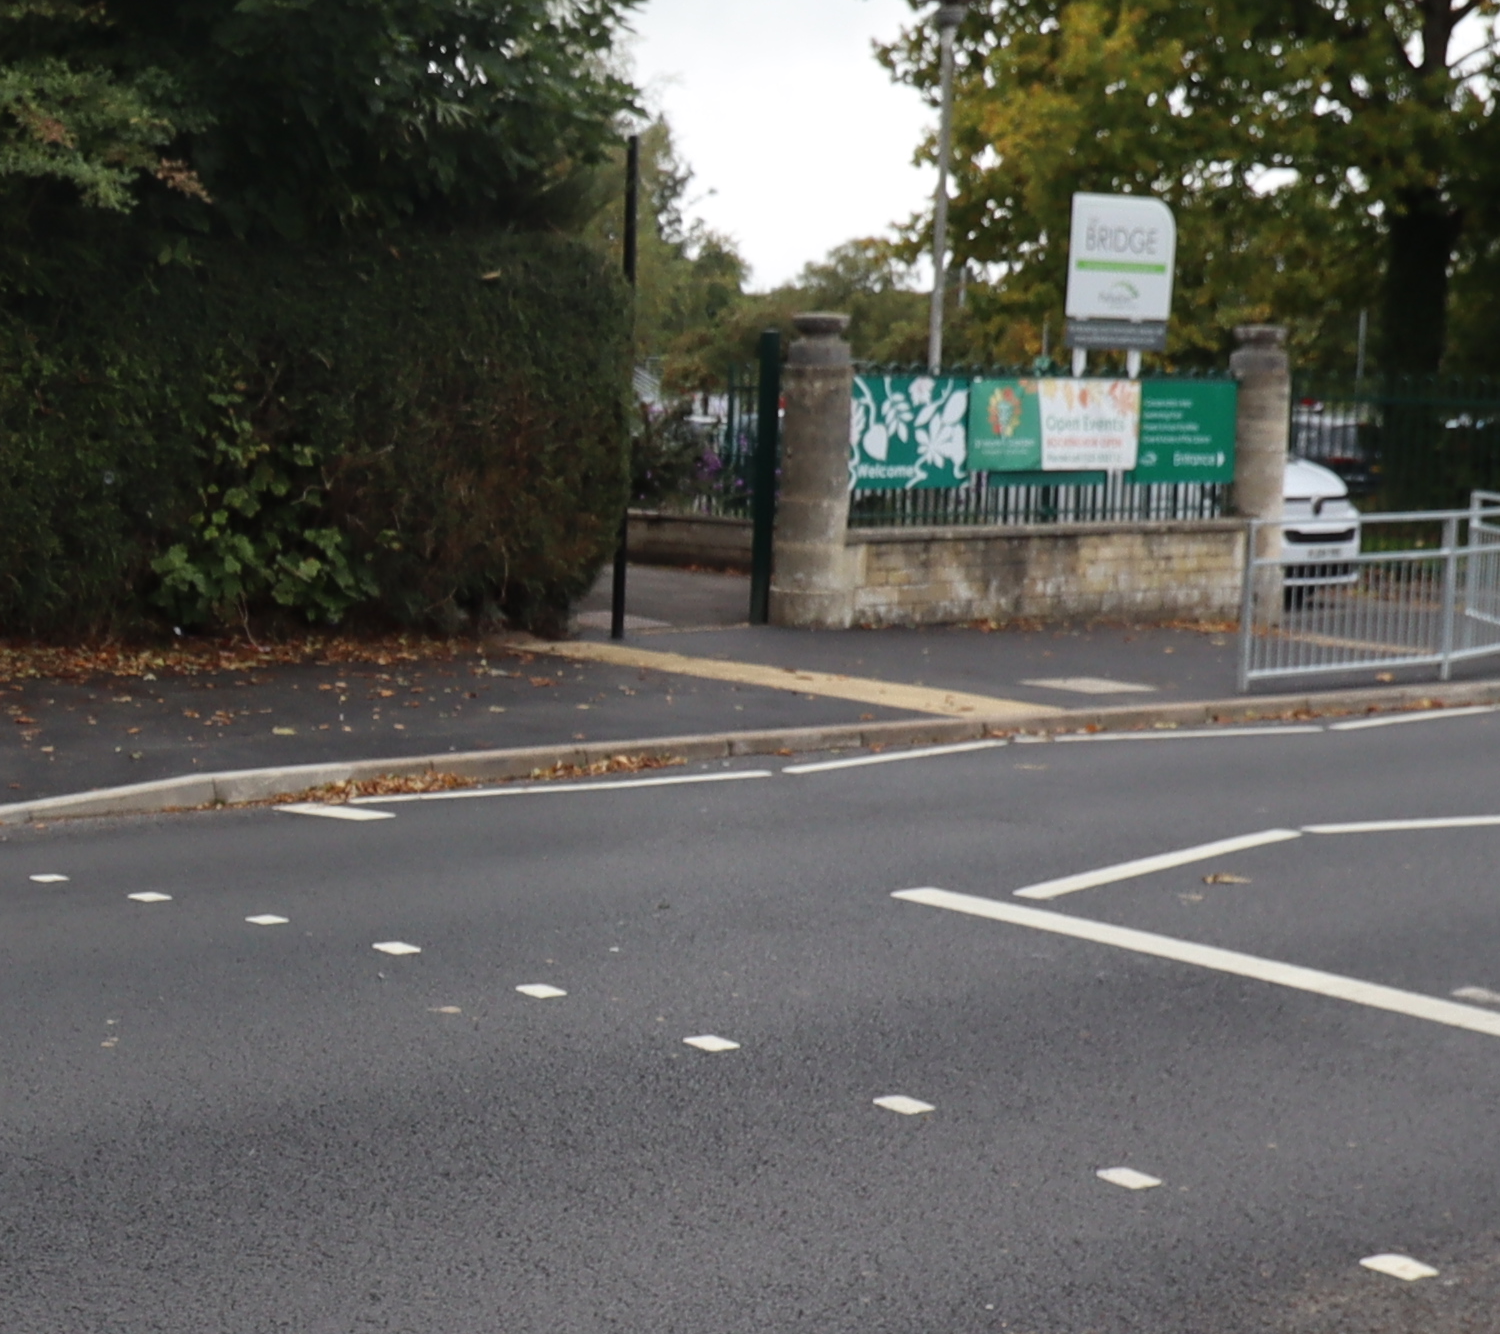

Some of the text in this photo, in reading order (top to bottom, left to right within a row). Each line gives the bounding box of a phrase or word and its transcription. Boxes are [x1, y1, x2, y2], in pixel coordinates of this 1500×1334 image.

[1085, 225, 1159, 255] BRIDGE
[1046, 415, 1080, 434] Open
[1082, 415, 1125, 433] Events
